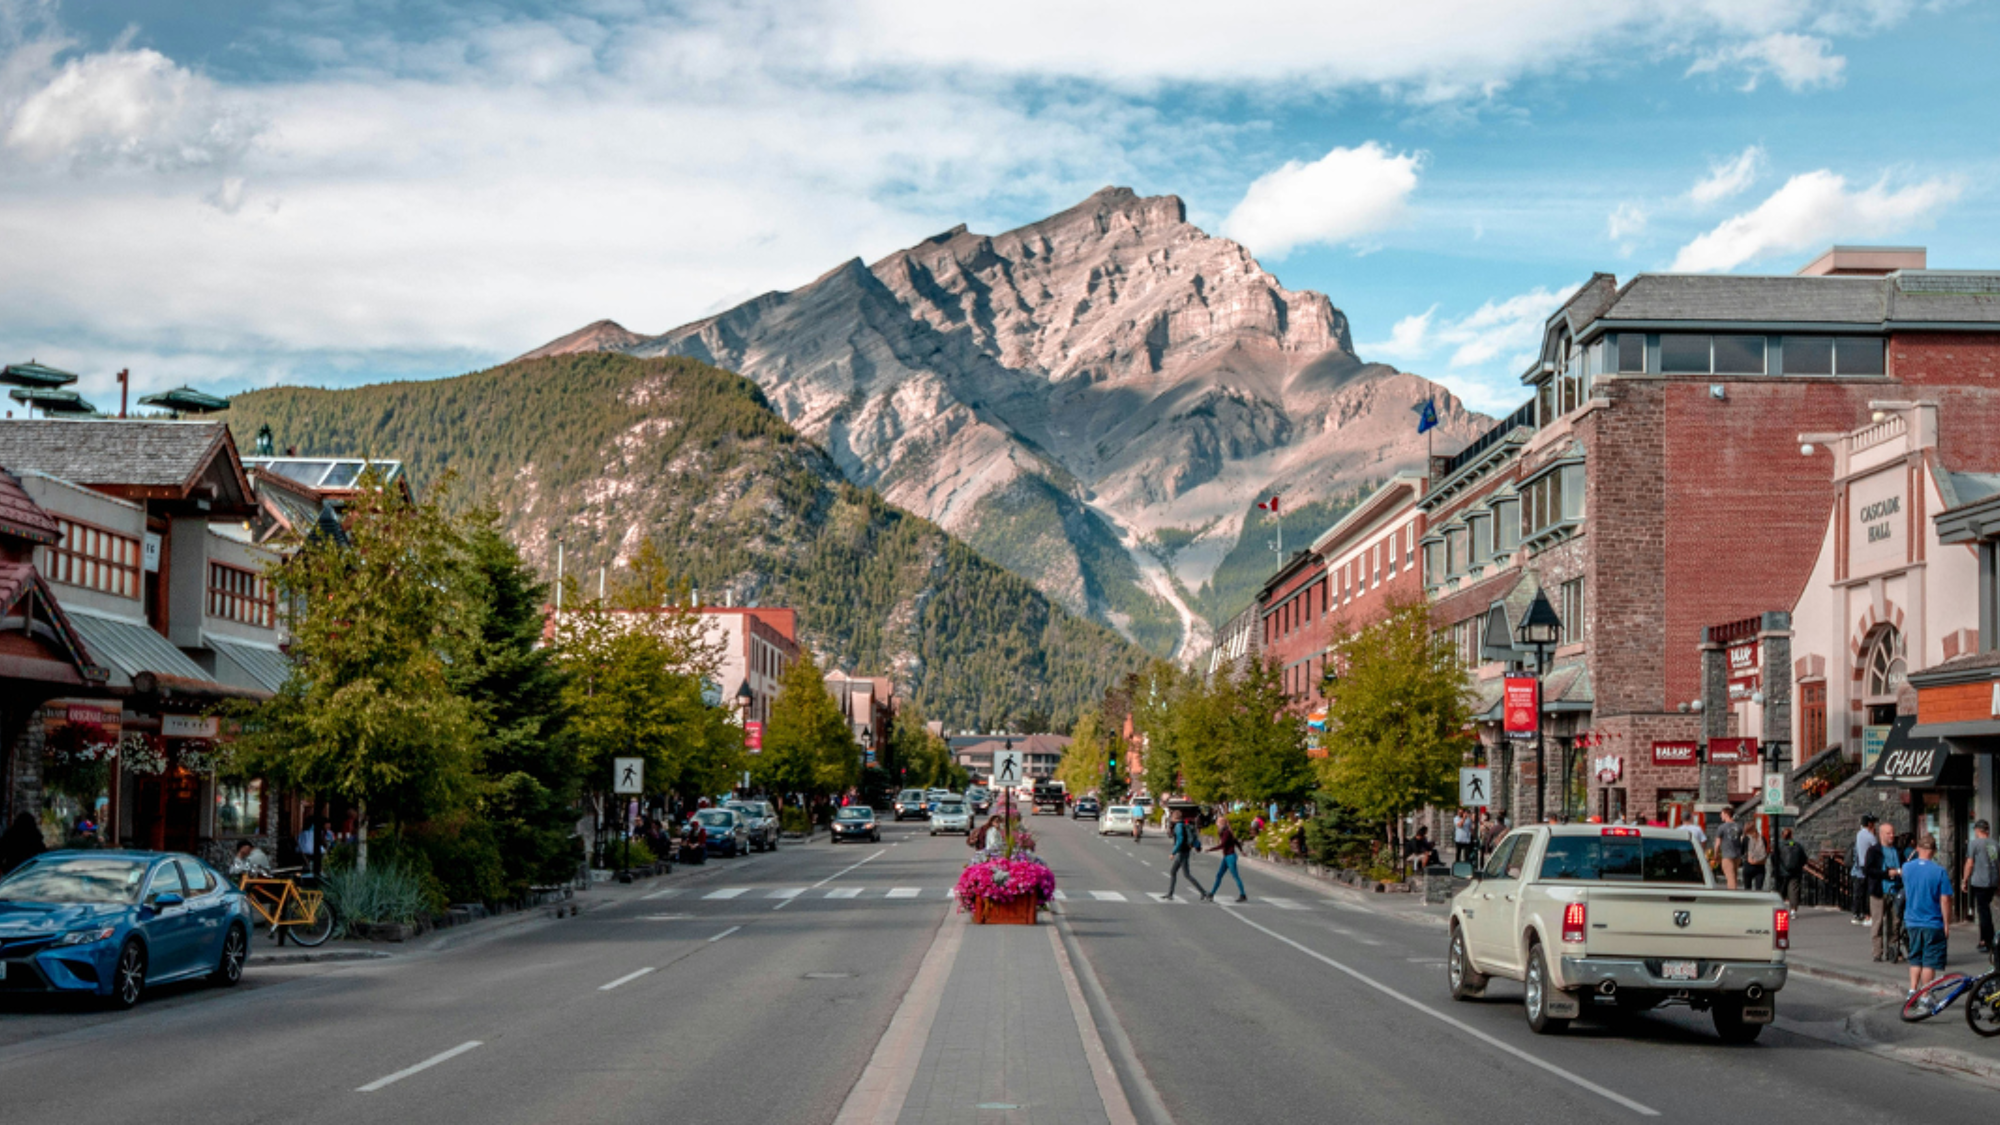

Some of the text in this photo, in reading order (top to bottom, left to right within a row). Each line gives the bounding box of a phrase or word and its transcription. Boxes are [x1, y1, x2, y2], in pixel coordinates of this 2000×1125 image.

[1860, 495, 1900, 523] CASCADE
[1868, 521, 1891, 543] HALL
[1884, 749, 1935, 775] CHAYA
